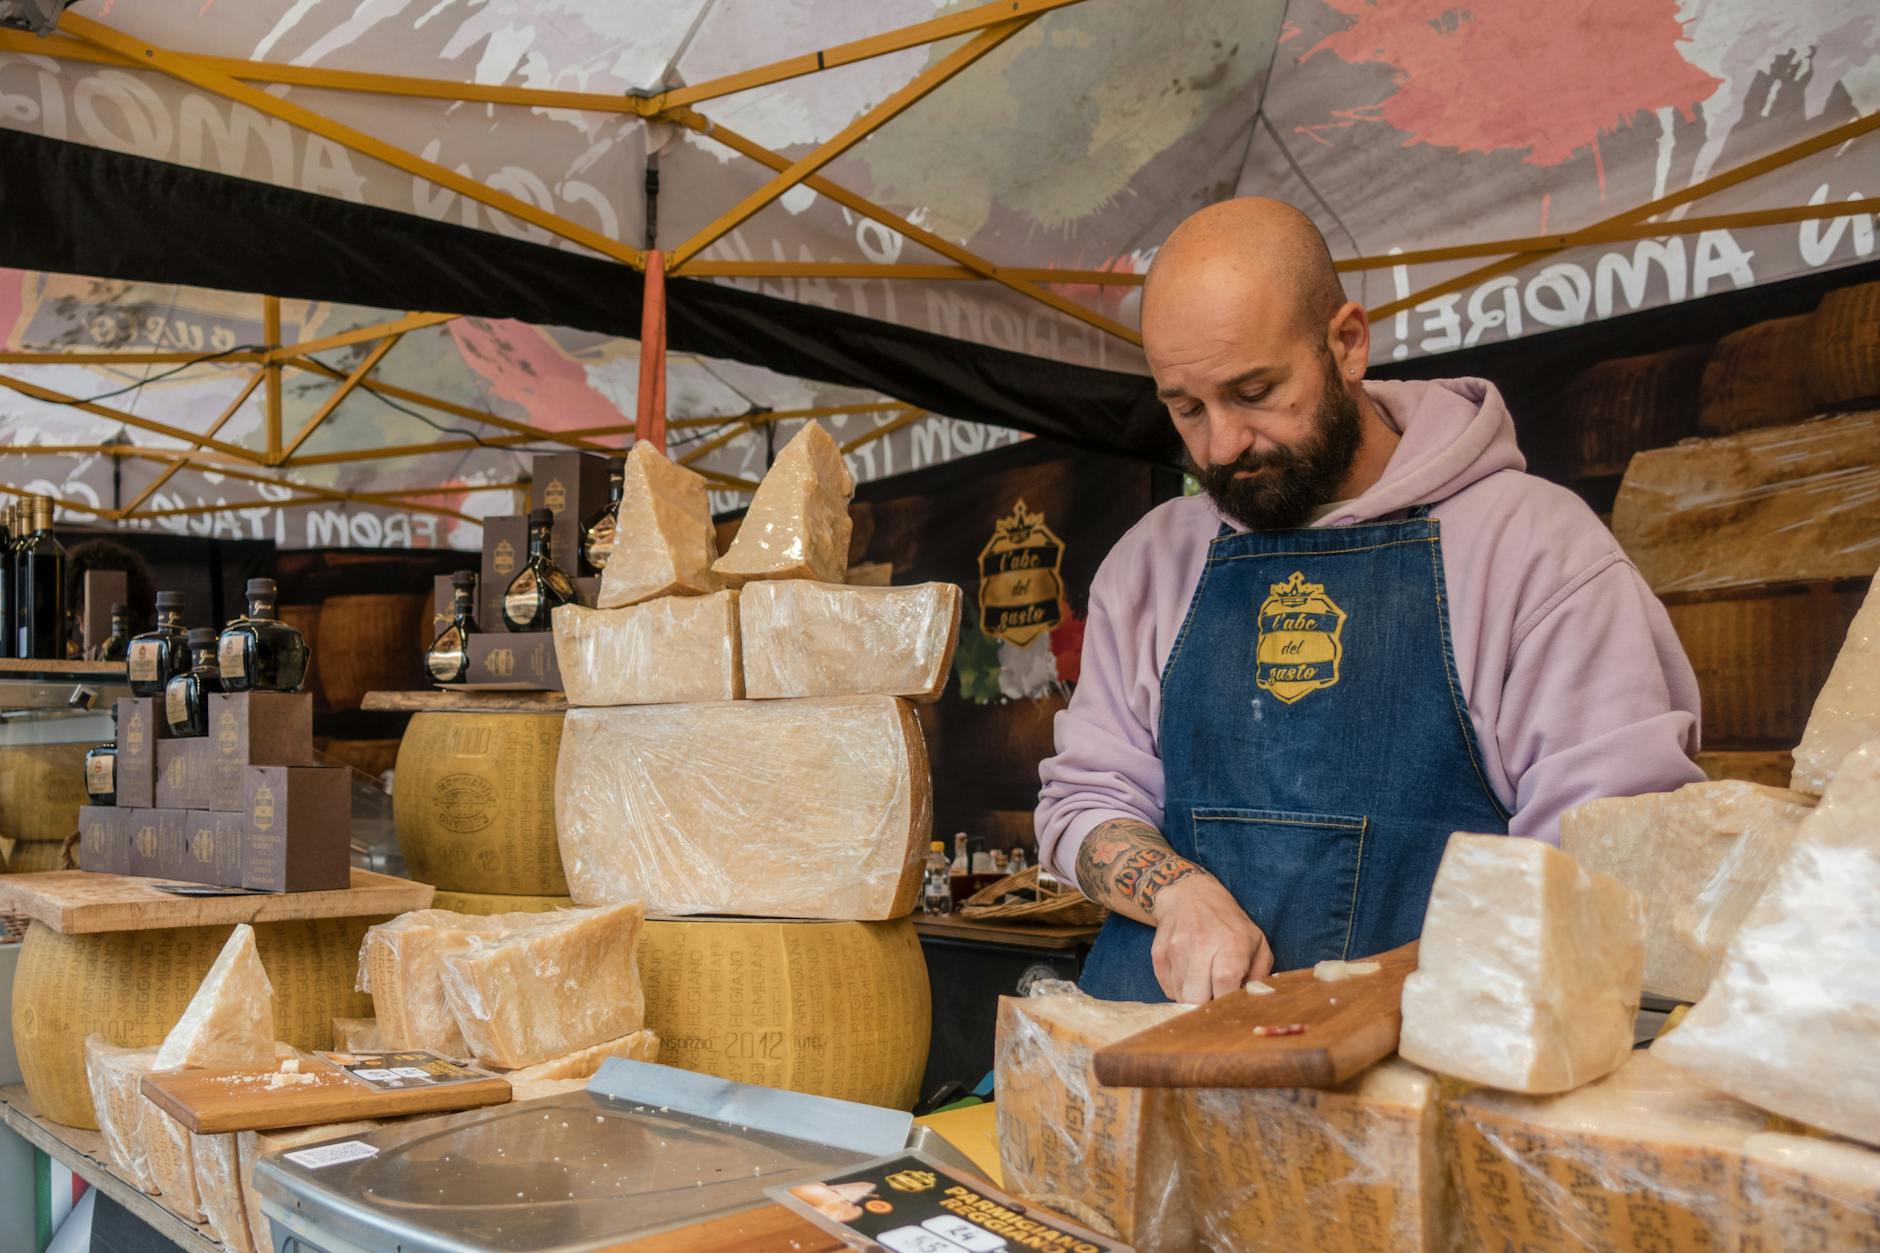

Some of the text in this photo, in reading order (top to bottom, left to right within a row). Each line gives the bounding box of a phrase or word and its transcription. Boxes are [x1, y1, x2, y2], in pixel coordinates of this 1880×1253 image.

[1281, 640, 1305, 655] del
[1268, 663, 1319, 687] gusto
[660, 1037, 713, 1050] NSORZIO
[725, 1031, 784, 1060] 2012
[938, 1198, 1067, 1253] REGGIANO
[943, 1185, 1100, 1253] PARMIGIANO
